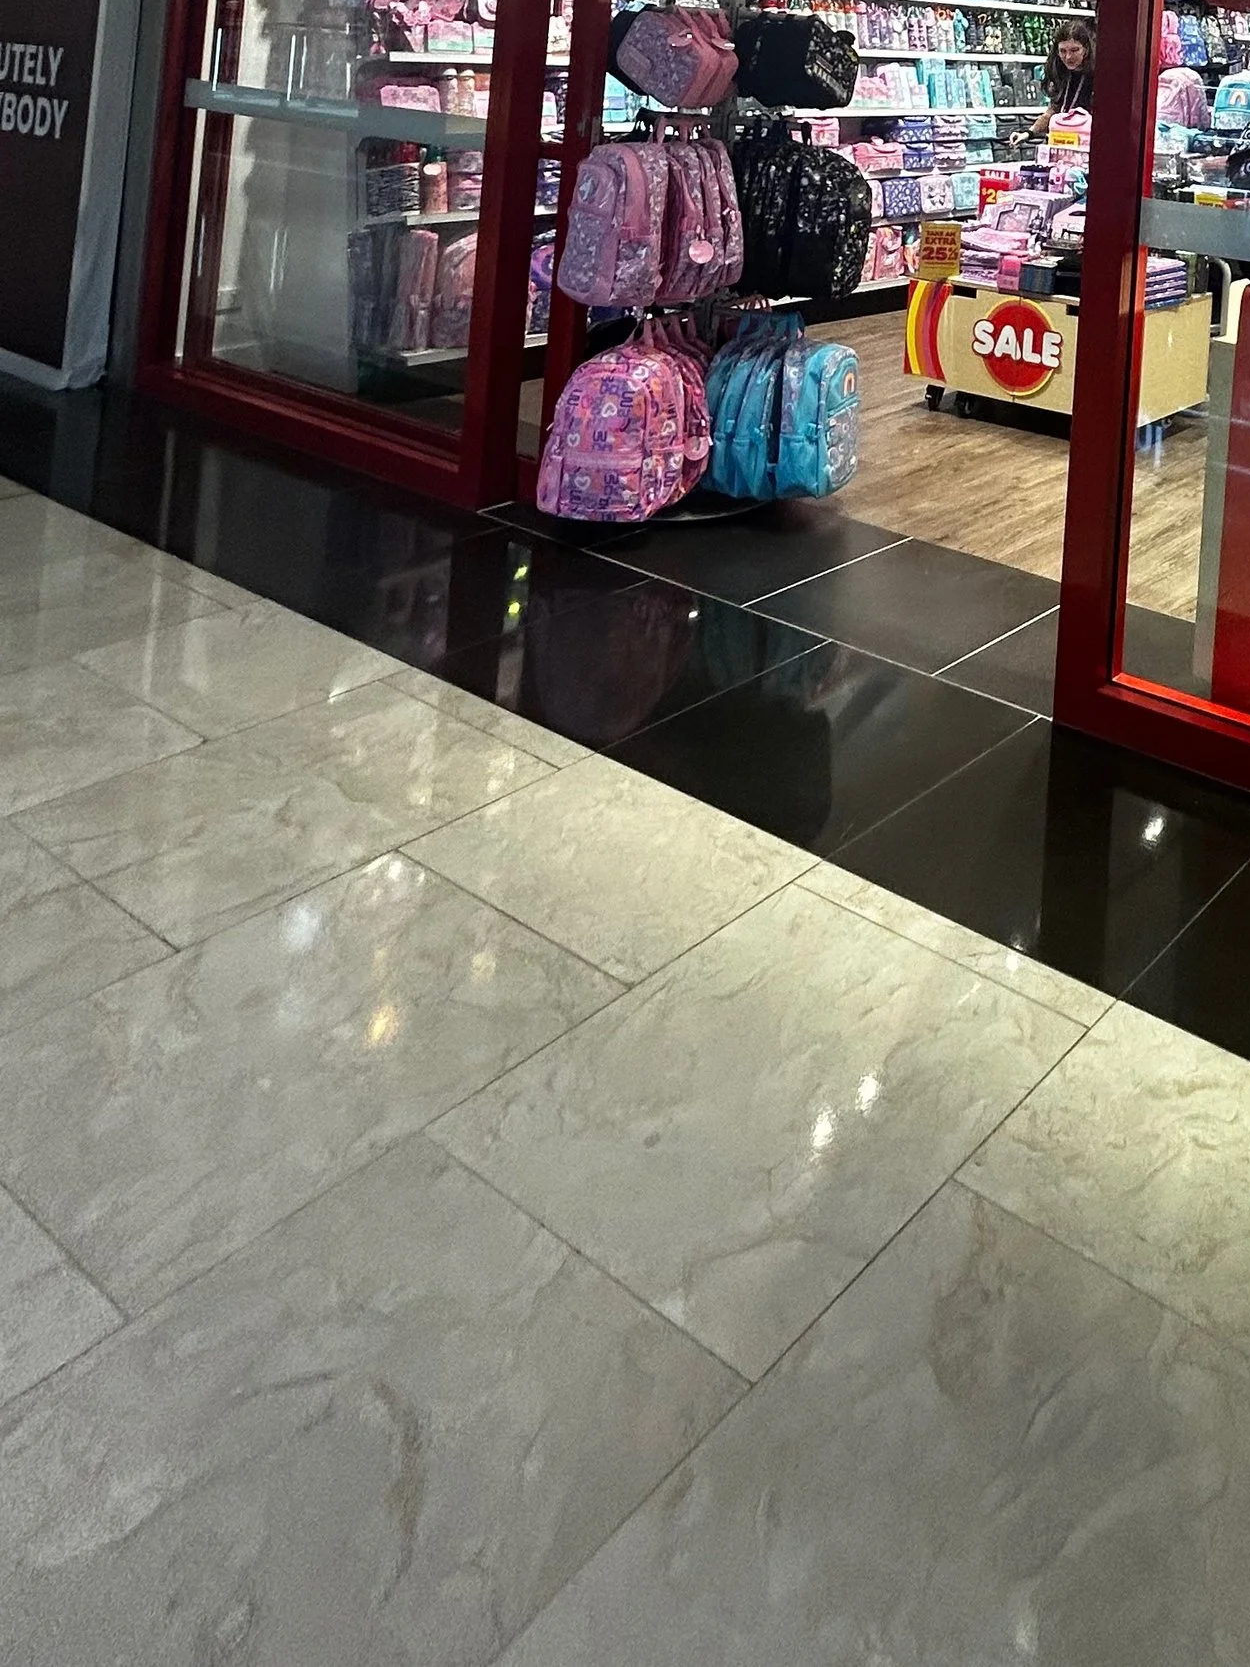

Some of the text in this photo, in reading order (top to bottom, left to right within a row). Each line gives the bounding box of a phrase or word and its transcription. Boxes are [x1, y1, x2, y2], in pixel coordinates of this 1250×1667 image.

[0, 91, 69, 140] BODY
[922, 246, 958, 262] 25%
[924, 237, 957, 246] EXTRA
[972, 318, 1062, 369] SALE
